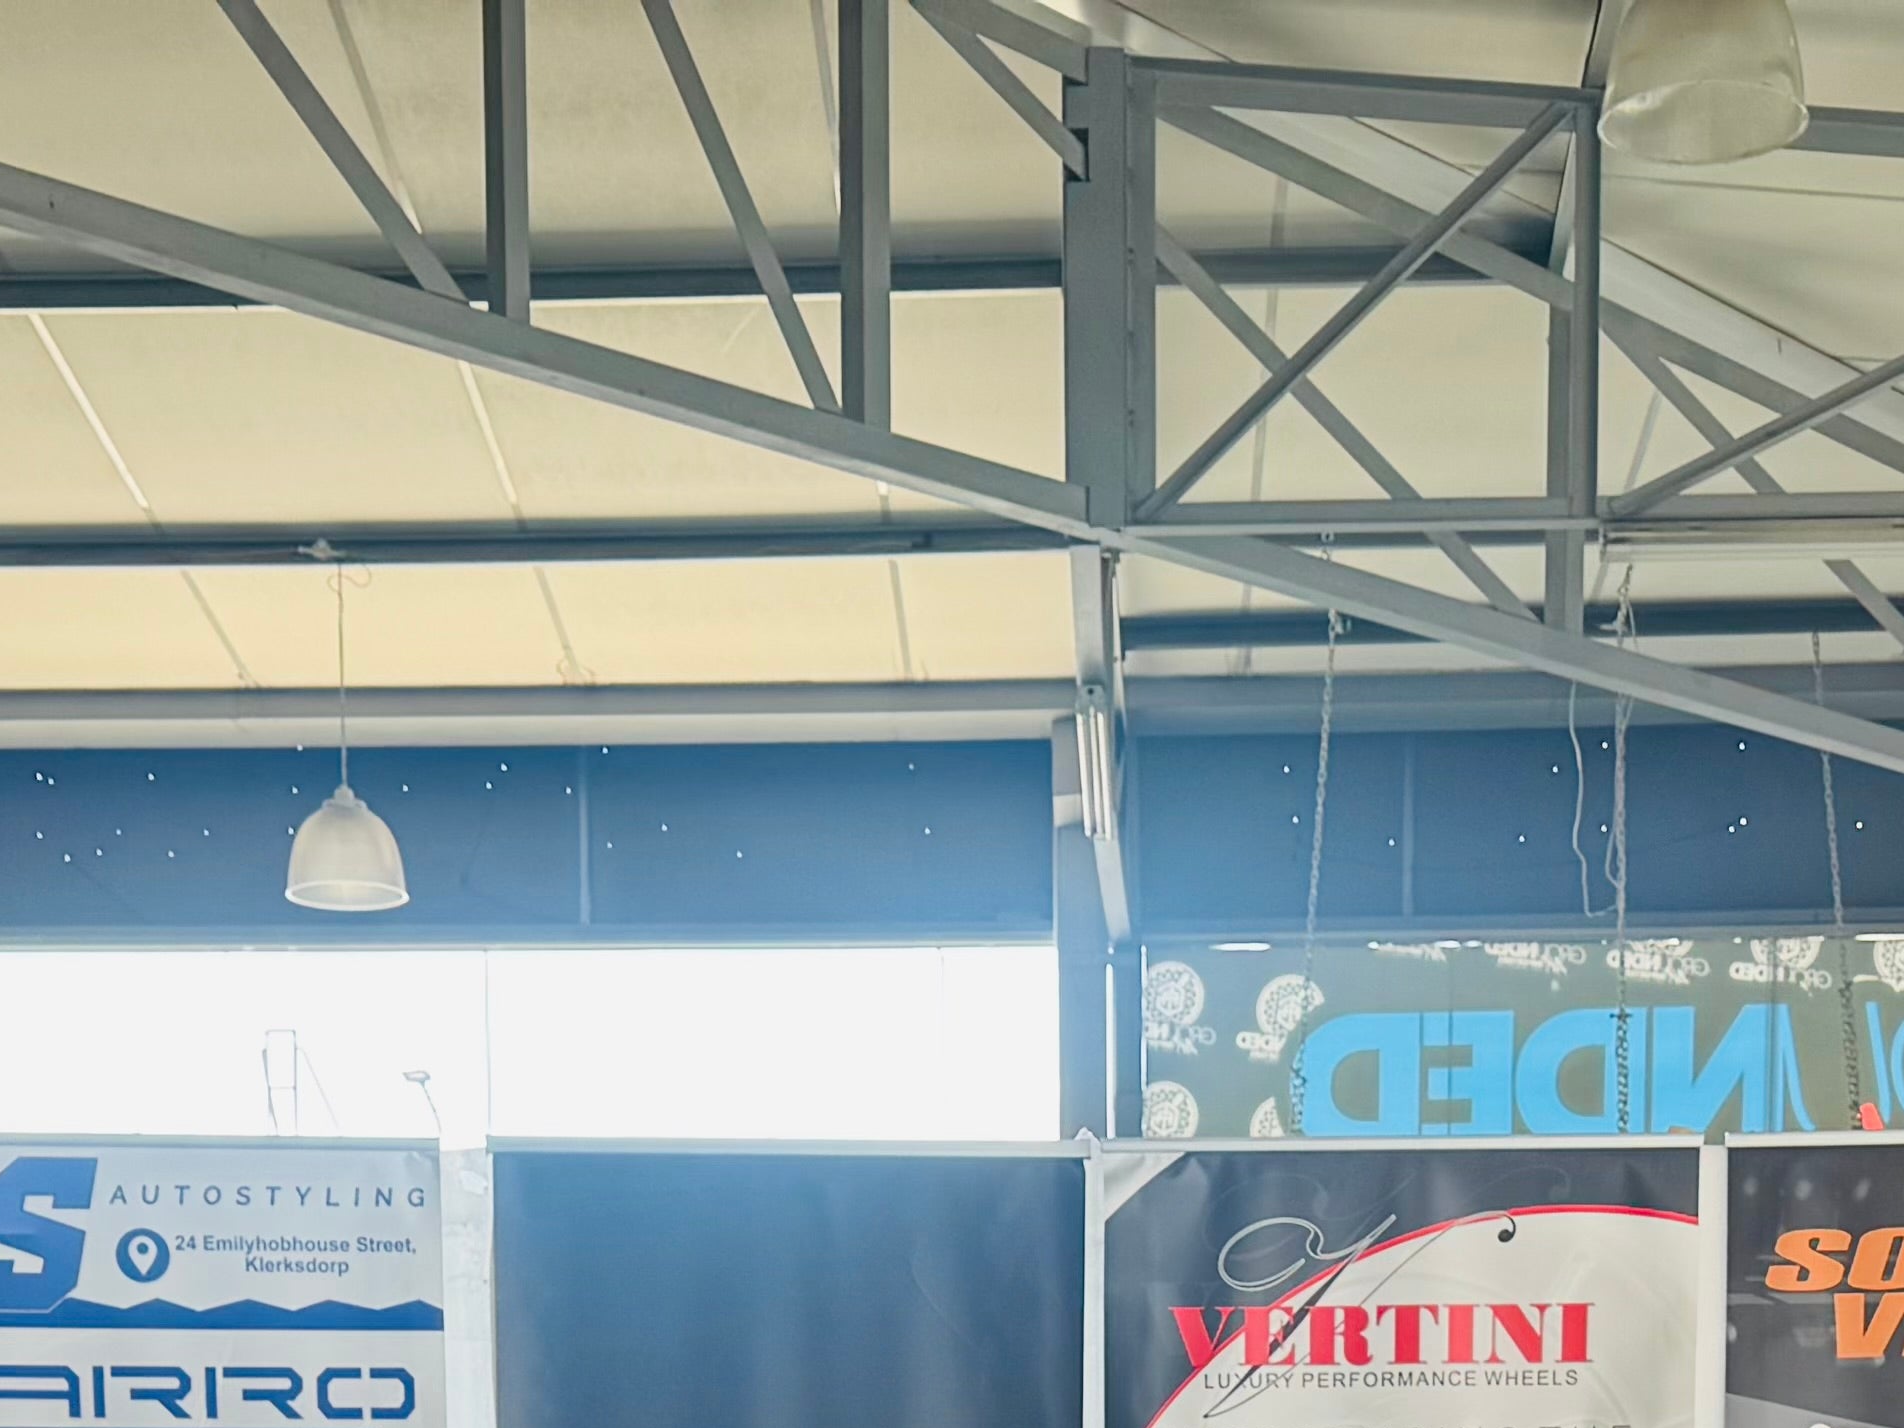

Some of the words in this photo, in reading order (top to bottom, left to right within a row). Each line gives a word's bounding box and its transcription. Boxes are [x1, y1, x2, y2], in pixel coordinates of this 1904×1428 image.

[108, 1184, 426, 1209] AUTOSTYLING
[174, 1235, 197, 1253] 24
[202, 1234, 351, 1256] Emilyhobhouse
[355, 1234, 417, 1255] Street,
[244, 1256, 350, 1278] Klerksdorp
[1167, 1302, 1596, 1369] VERTINI
[1203, 1370, 1294, 1391] LUXURY
[1301, 1370, 1476, 1389] PERFORMANCE
[1483, 1369, 1579, 1387] WHEELS
